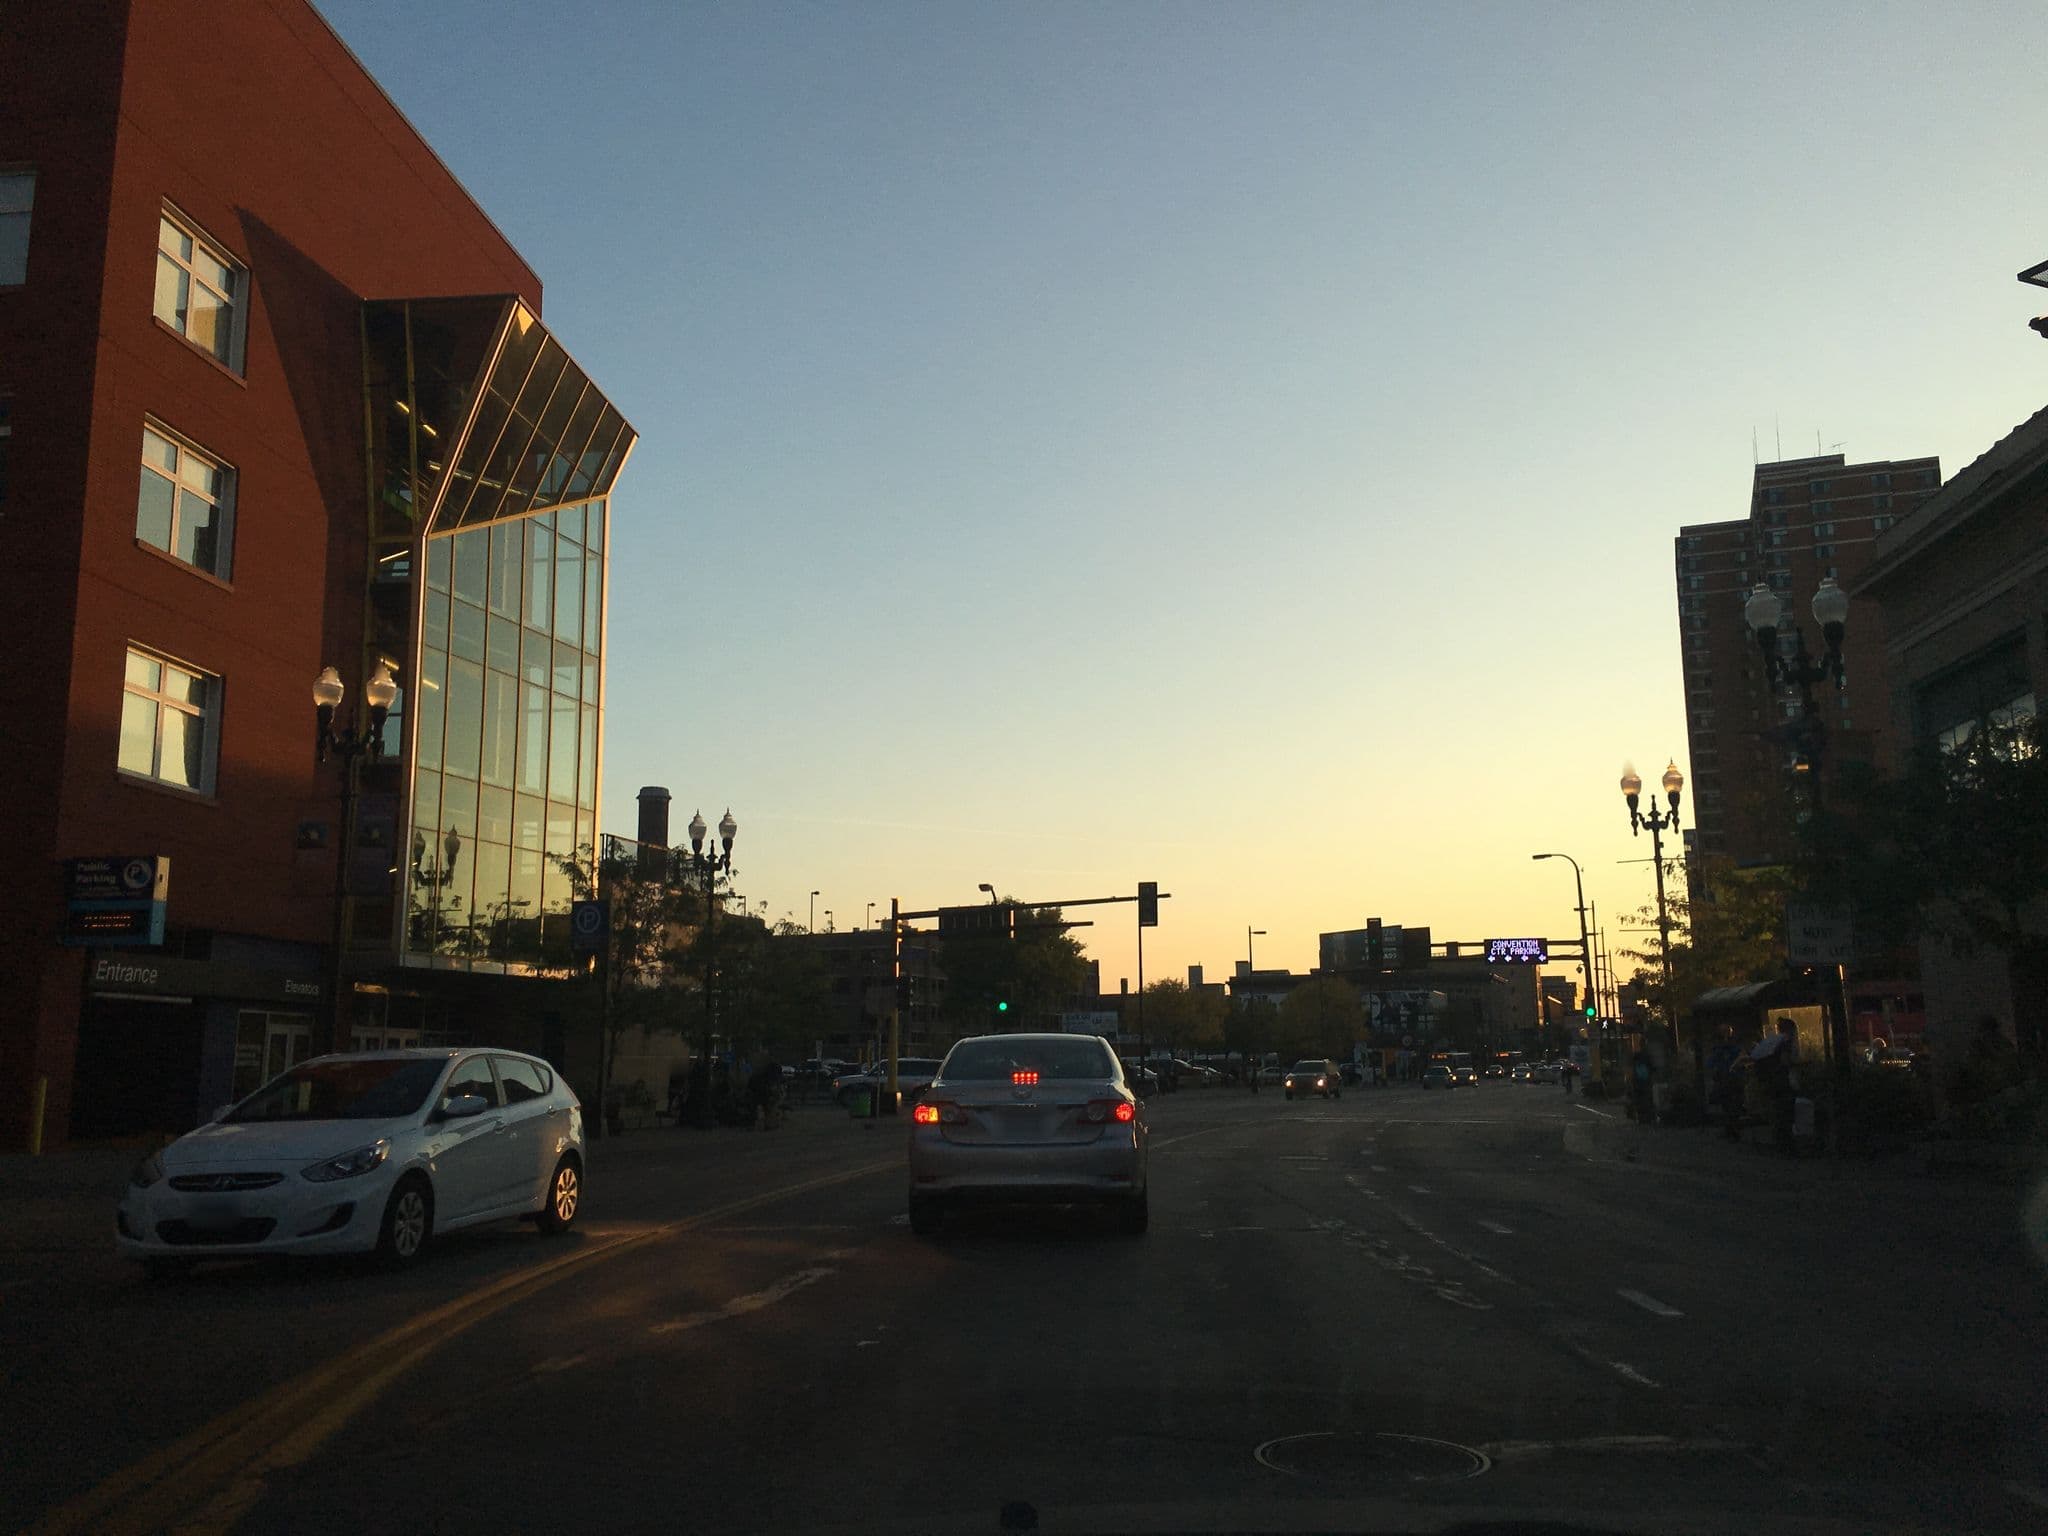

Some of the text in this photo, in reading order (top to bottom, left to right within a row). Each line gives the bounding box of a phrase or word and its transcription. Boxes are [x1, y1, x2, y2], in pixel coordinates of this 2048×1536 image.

[1492, 939, 1539, 948] CONVENTION
[1490, 947, 1541, 956] CTR PARKING
[96, 960, 158, 983] Entrance
